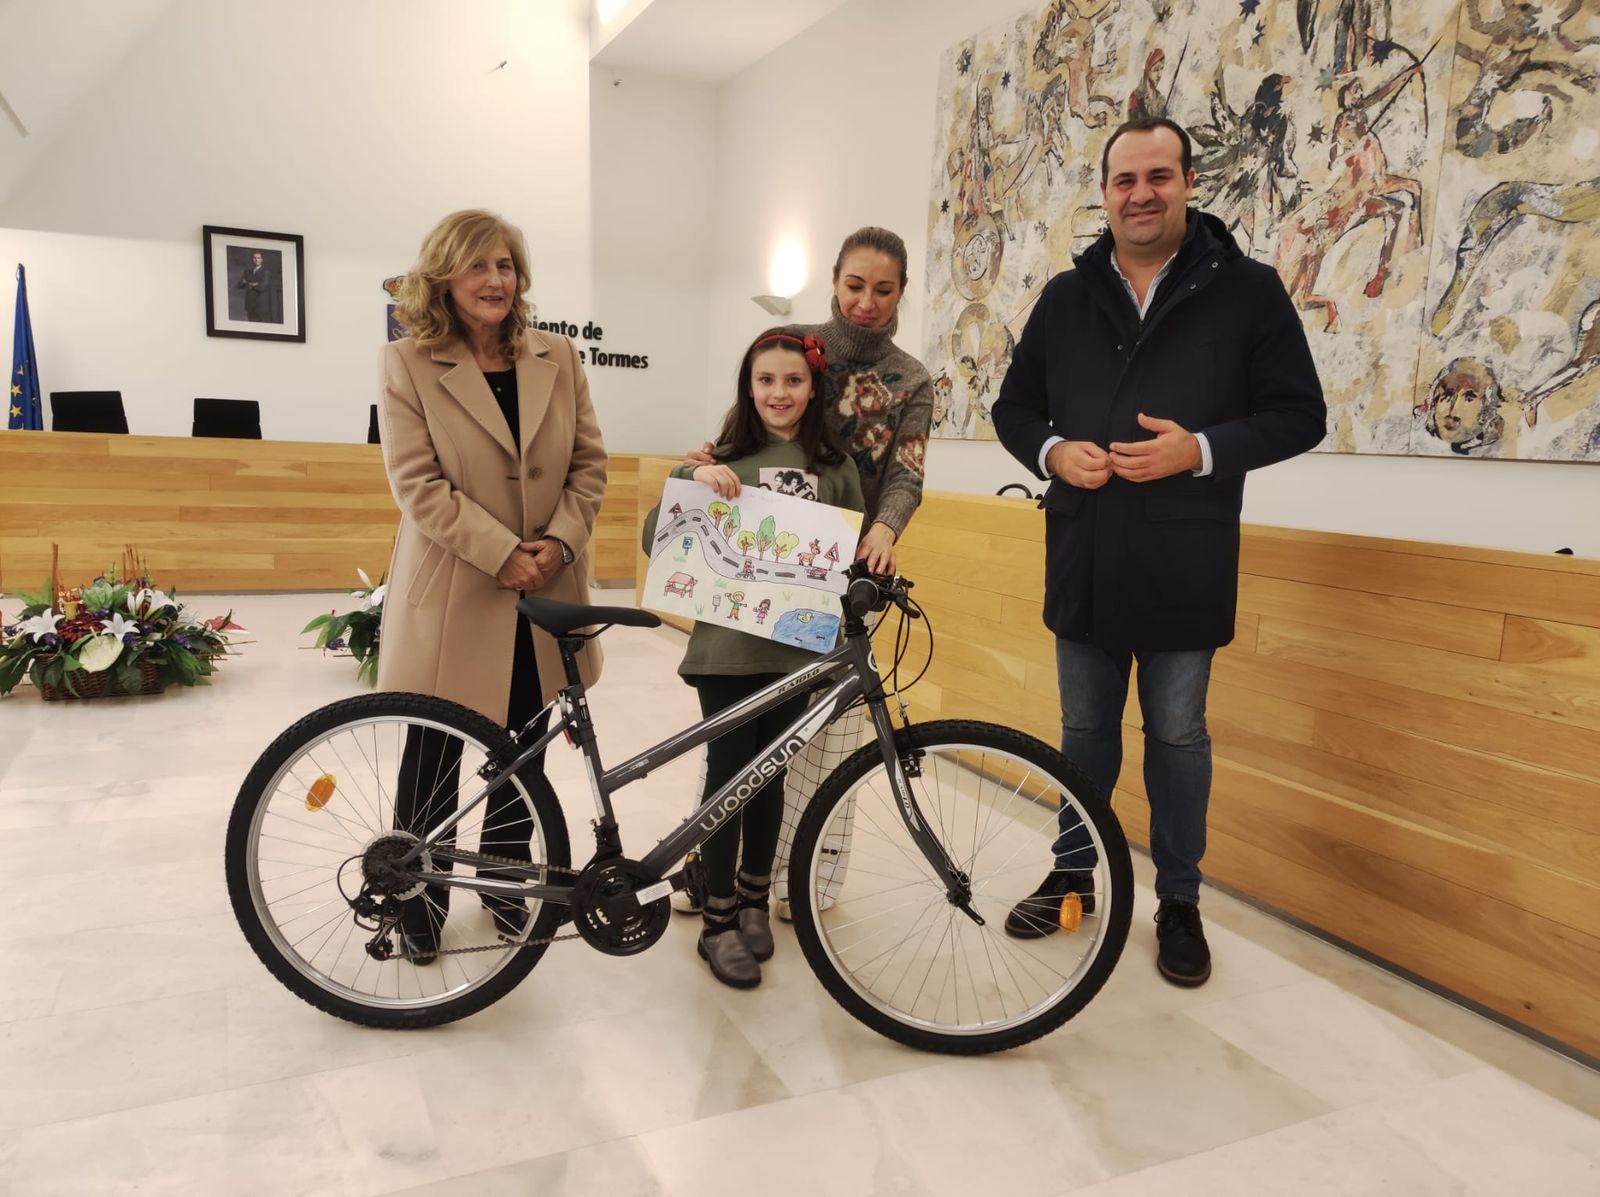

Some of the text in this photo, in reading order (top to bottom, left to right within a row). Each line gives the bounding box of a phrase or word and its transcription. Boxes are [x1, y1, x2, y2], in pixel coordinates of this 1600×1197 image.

[528, 315, 603, 340] iento de
[589, 347, 649, 369] Tormes
[700, 738, 804, 831] woodsun
